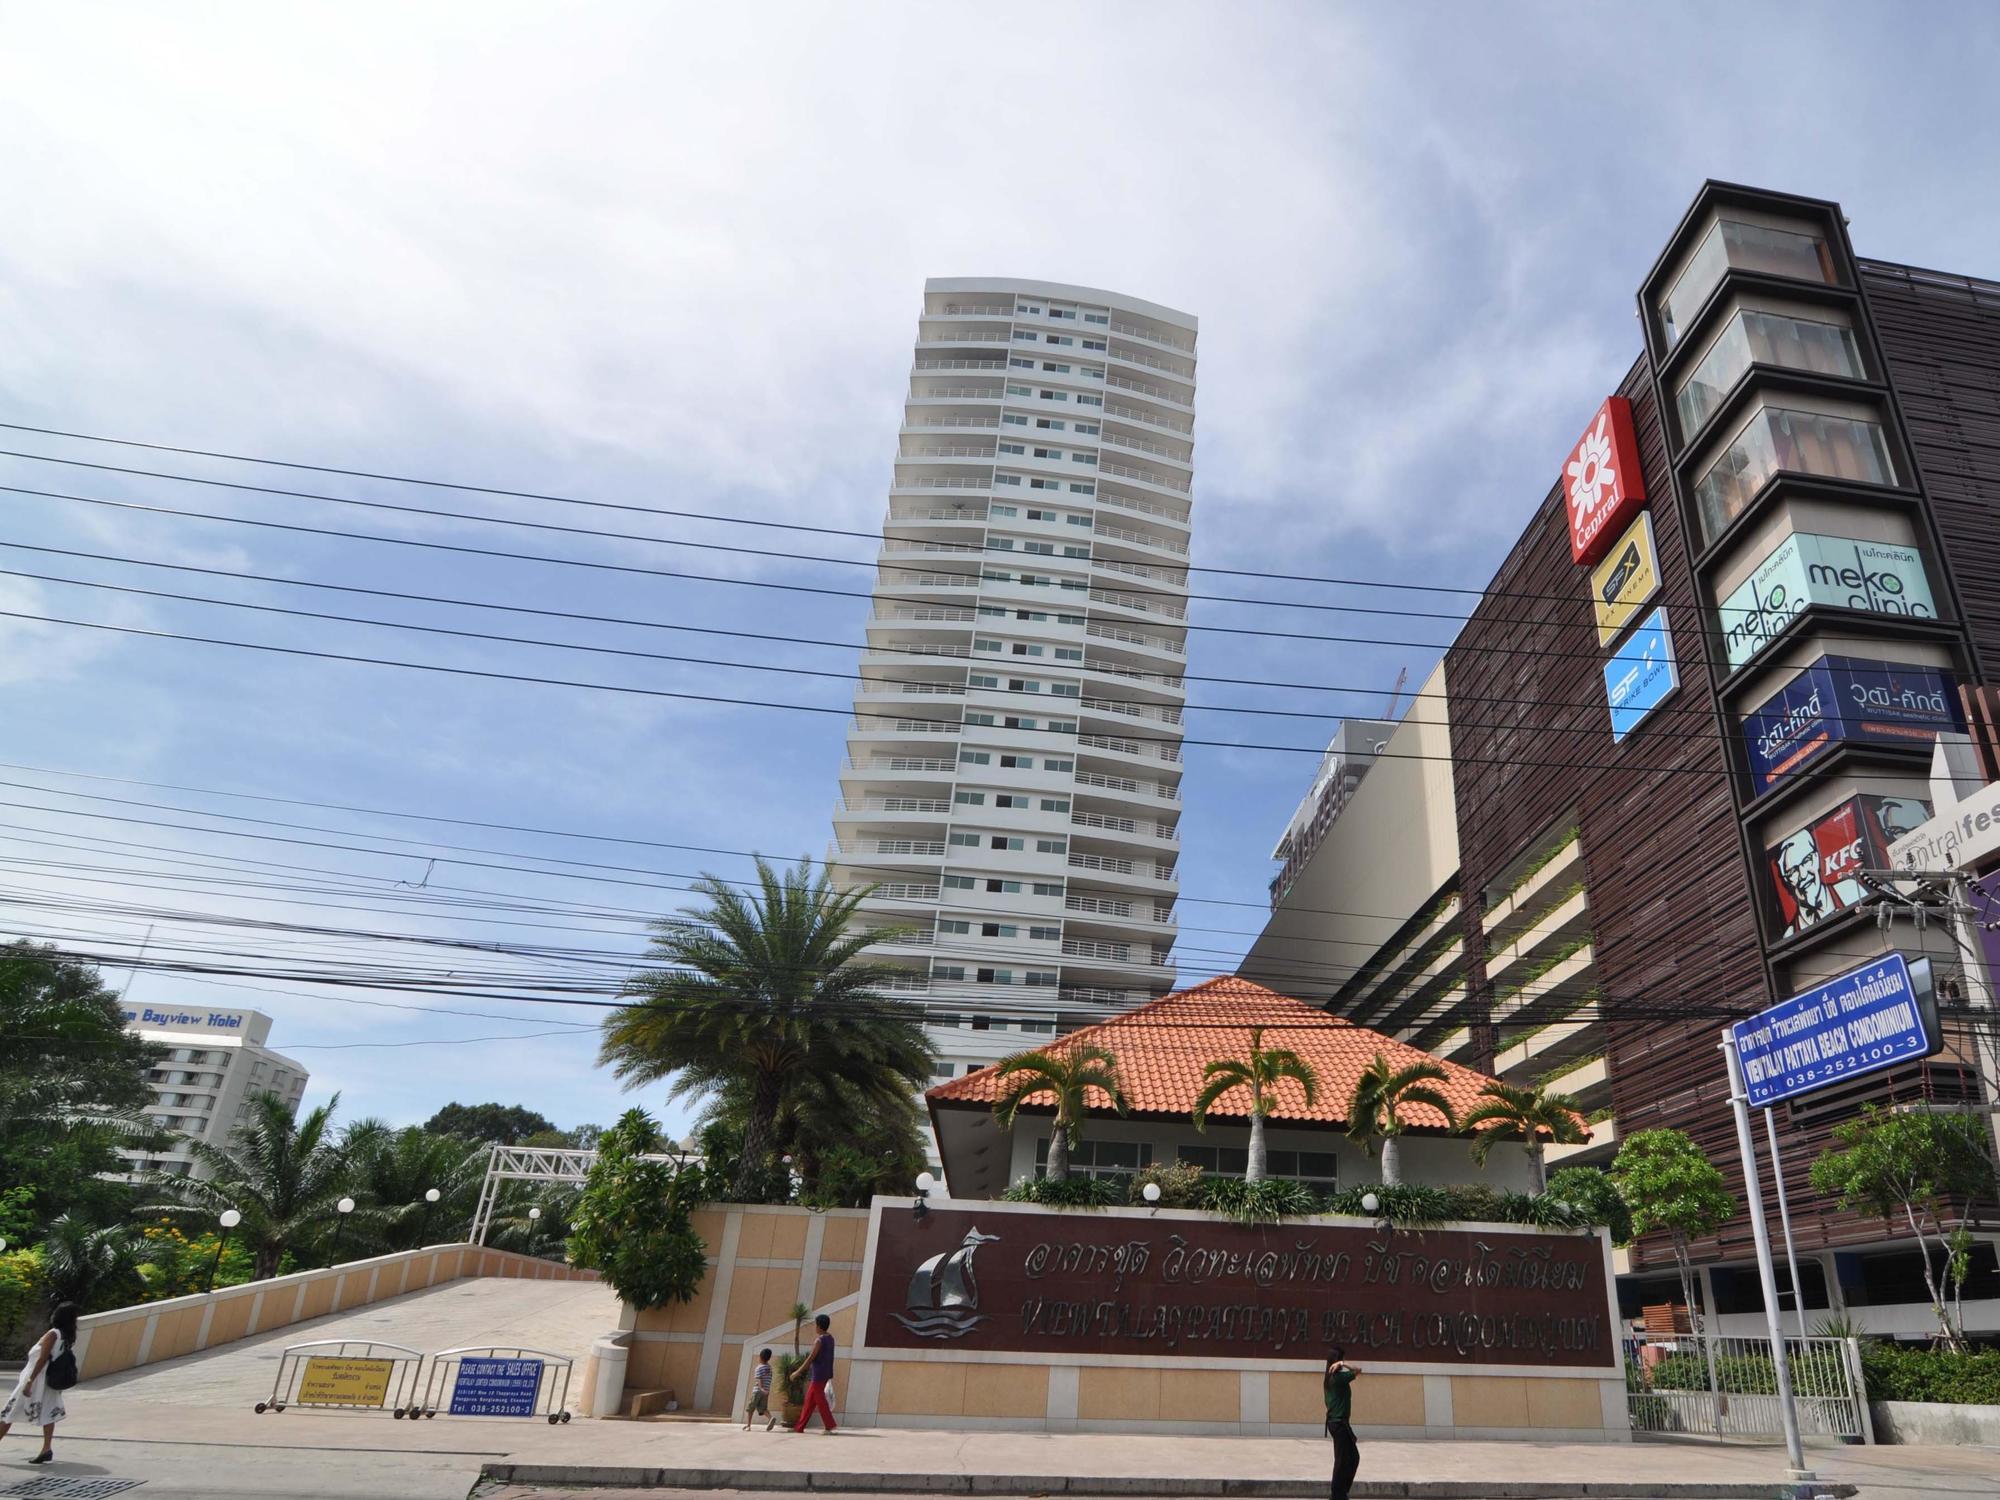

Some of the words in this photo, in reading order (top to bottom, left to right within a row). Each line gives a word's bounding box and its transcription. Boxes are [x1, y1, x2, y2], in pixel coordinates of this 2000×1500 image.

[1576, 484, 1620, 550] Central
[1619, 568, 1650, 606] CINEMA
[1809, 544, 1904, 596] meko
[1726, 579, 1787, 654] meko
[1610, 665, 1639, 701] SF
[1614, 686, 1642, 717] STRIKE
[1643, 662, 1666, 689] BOWL
[1824, 837, 1864, 876] KFC
[142, 1008, 203, 1026] Bayview
[208, 1013, 243, 1028] Hotel
[1745, 1049, 1786, 1084] VIEWTALAY
[1783, 1037, 1822, 1072] PATTAYA
[1820, 1026, 1850, 1060] BEACH
[1848, 1001, 1915, 1048] CONDOMINIUM
[1753, 1083, 1779, 1098] Tel.
[1320, 1308, 1404, 1346] BEACH
[1412, 1310, 1600, 1357] CONDOMINIUM
[460, 1363, 477, 1375] PLEASE
[477, 1364, 497, 1375] CONTACT
[496, 1364, 505, 1376] THE
